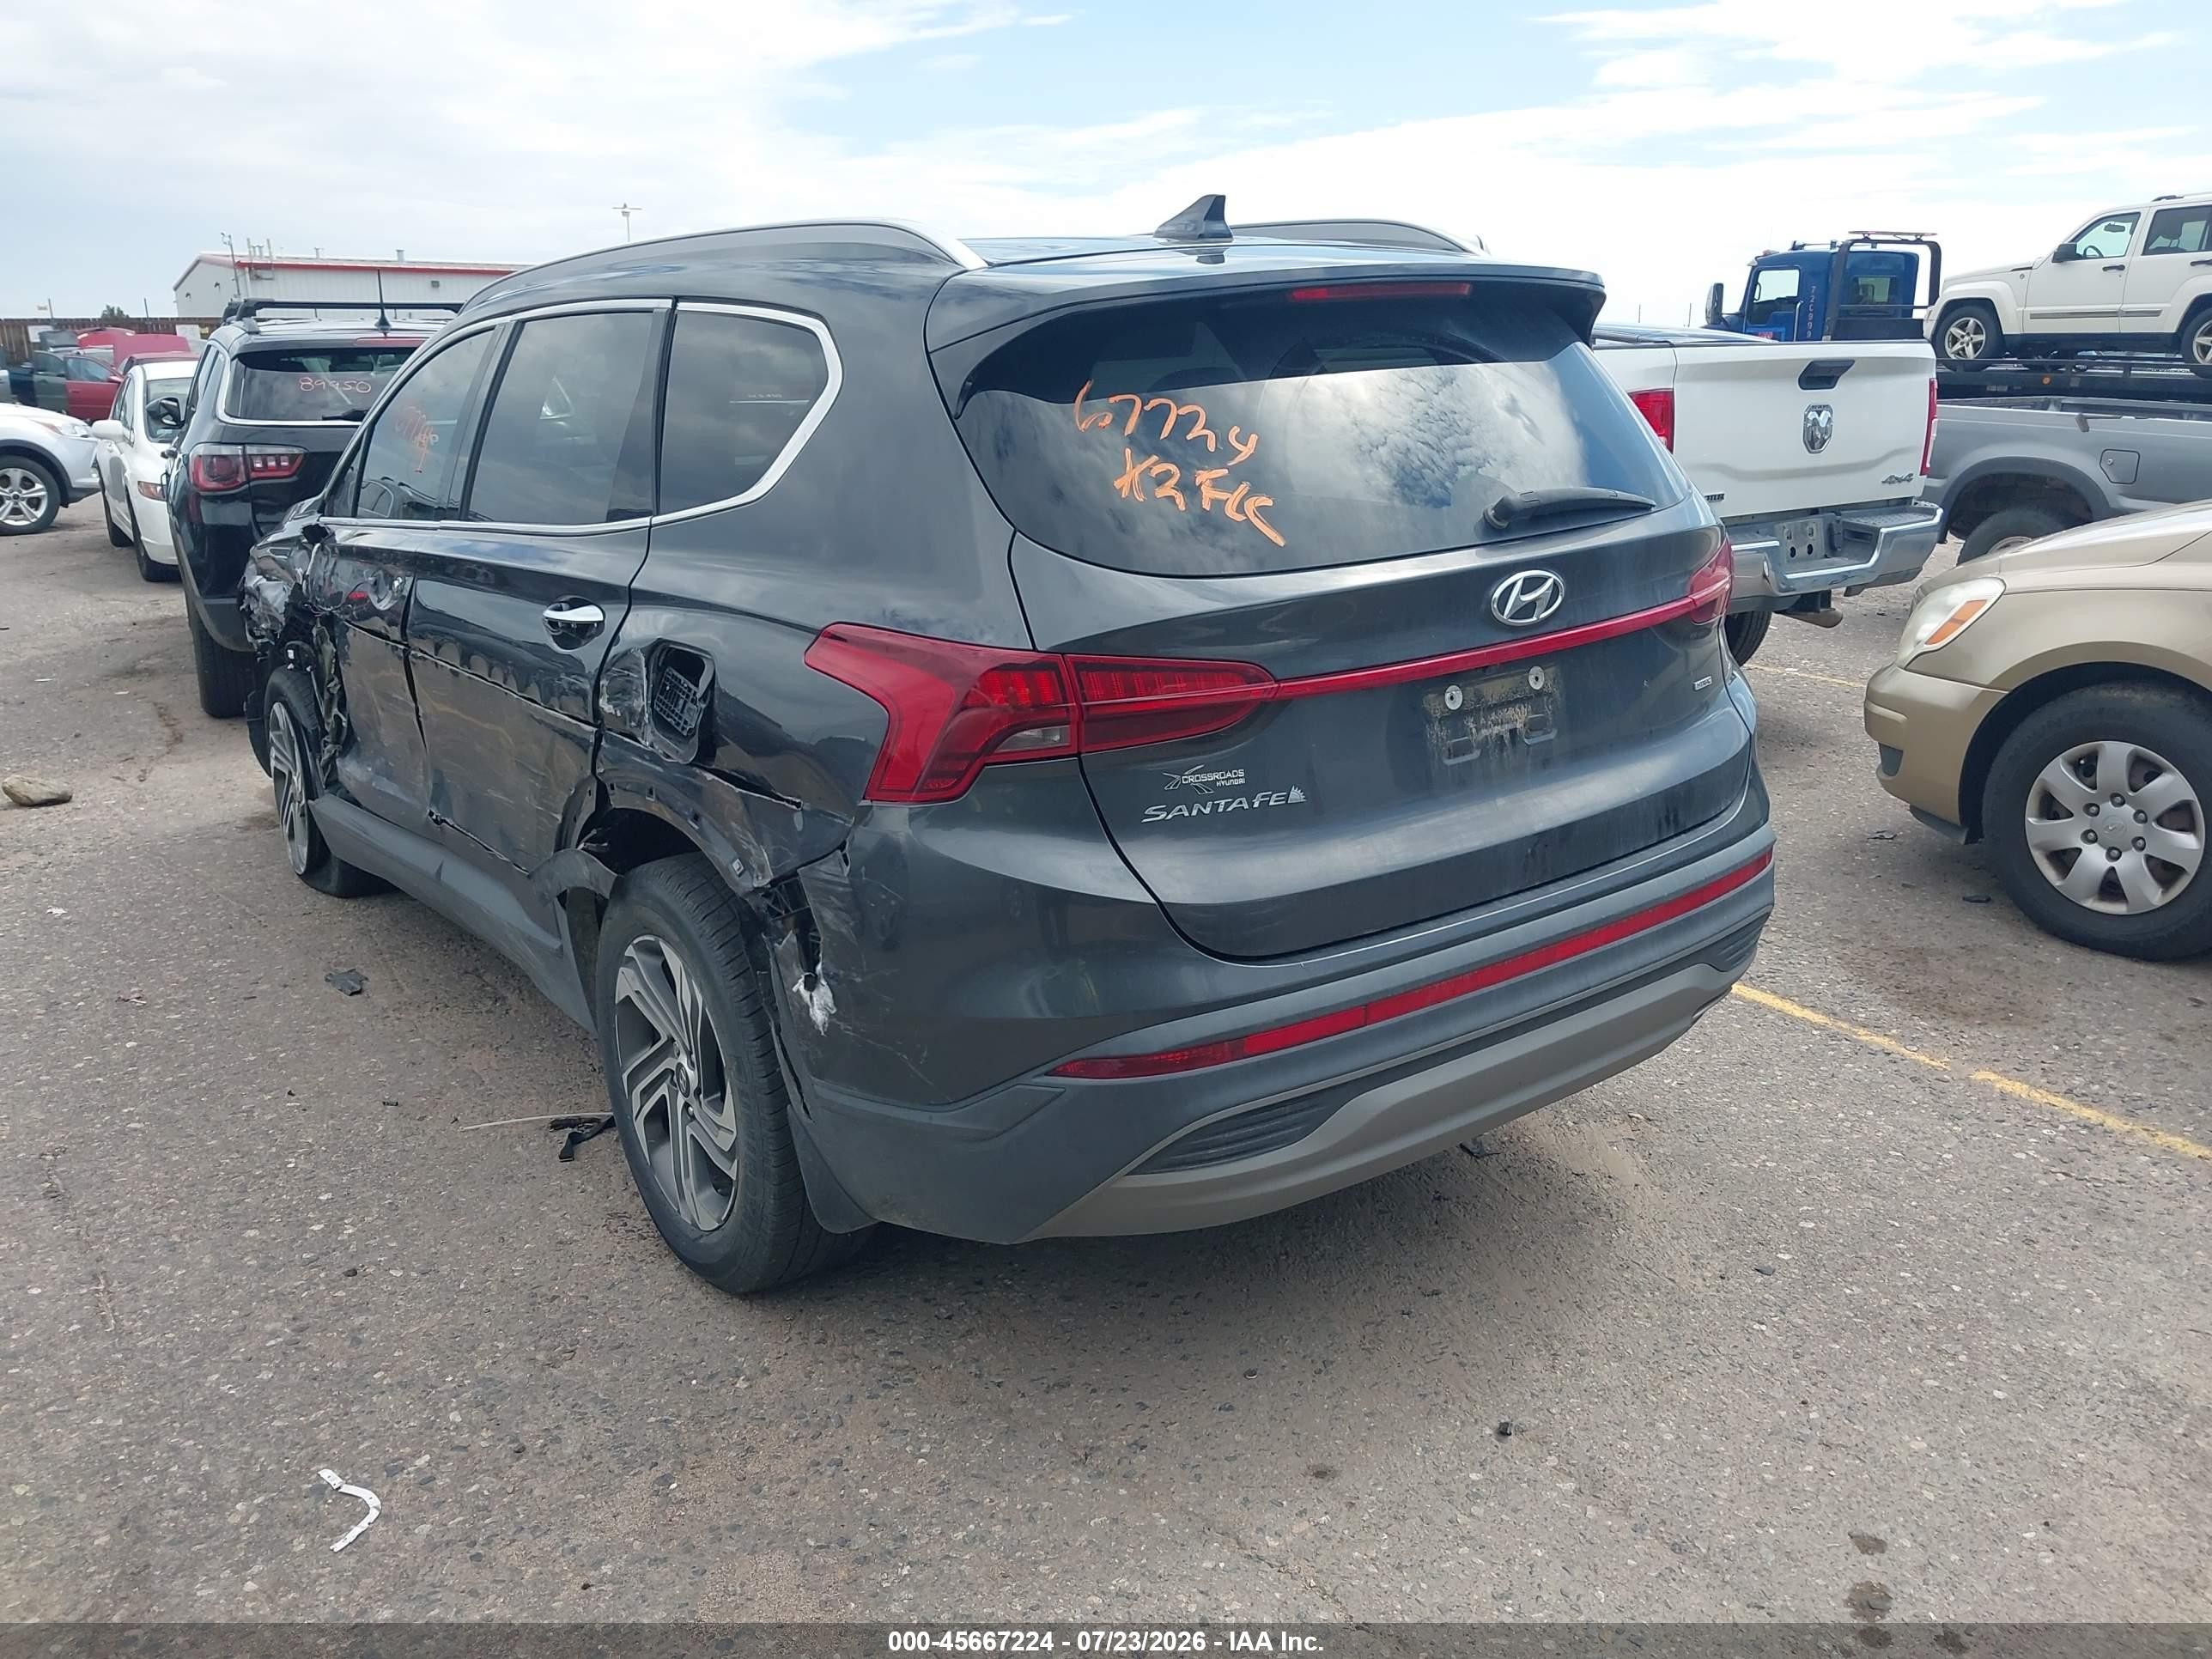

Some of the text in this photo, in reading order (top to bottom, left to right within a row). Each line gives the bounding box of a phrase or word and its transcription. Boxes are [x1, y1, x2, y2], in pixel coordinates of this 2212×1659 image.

[1182, 769, 1245, 784] CROSSROADS
[1216, 778, 1246, 787] HYUNDAI
[1141, 791, 1287, 823] SANTA FE
